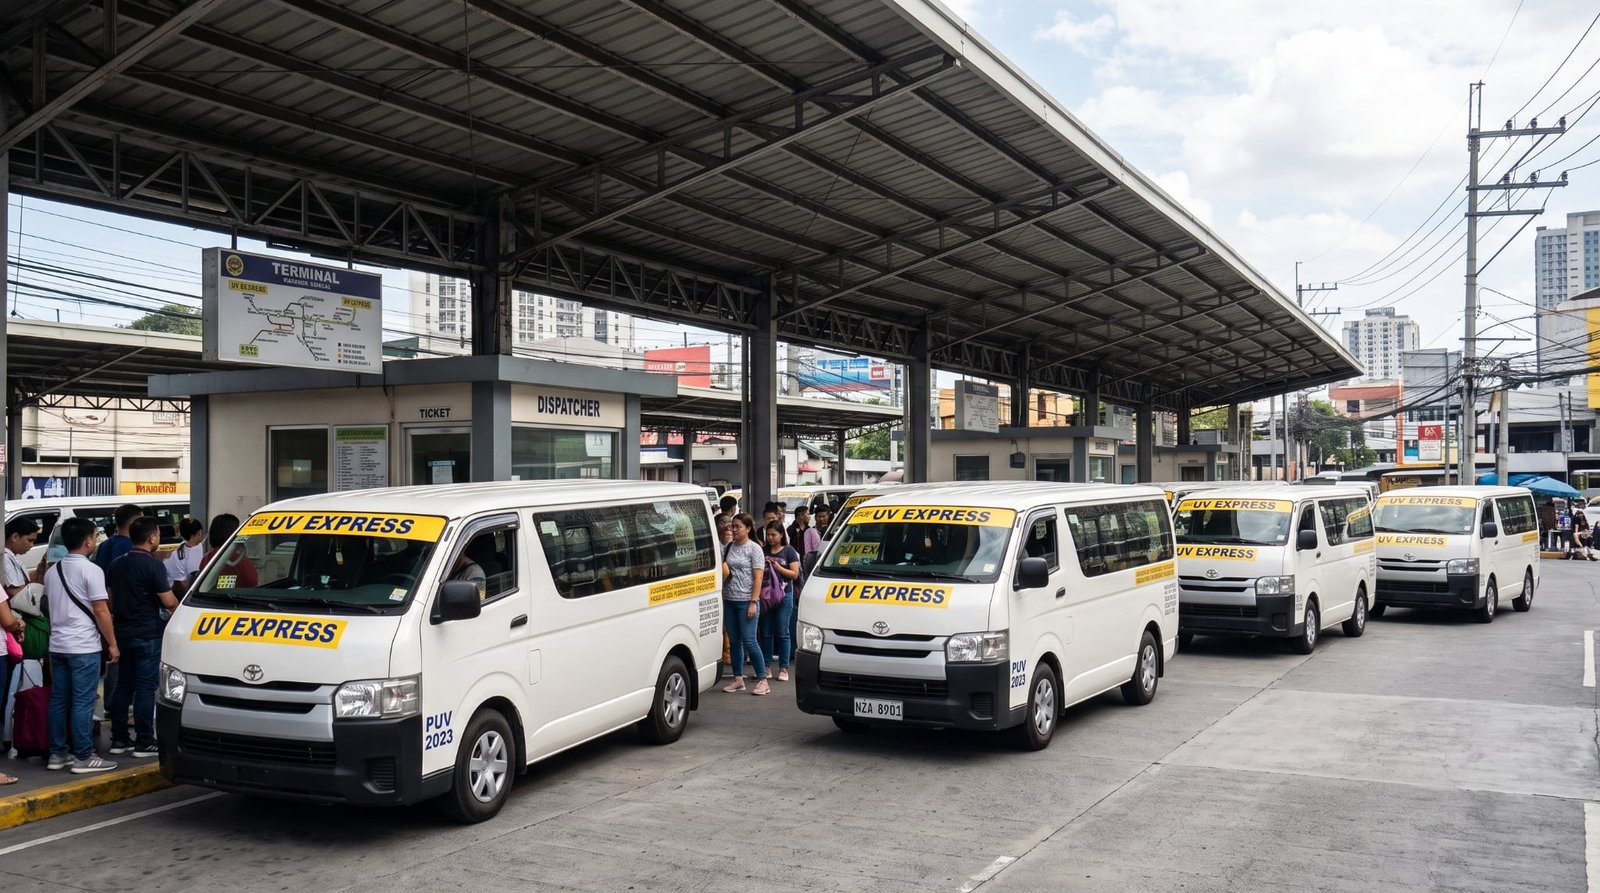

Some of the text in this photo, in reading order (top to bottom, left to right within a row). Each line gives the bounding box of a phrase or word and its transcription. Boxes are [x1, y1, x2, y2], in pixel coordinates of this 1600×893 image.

[272, 262, 340, 284] TERMINAL
[419, 408, 451, 419] TICKET
[537, 395, 600, 418] DISPATCHER
[1193, 501, 1212, 509] UV
[1214, 501, 1276, 510] EXPRESS
[1408, 498, 1463, 506] EXPRESS
[873, 509, 900, 520] UV
[902, 509, 991, 523] EXPRESS
[268, 516, 304, 531] UV
[304, 516, 415, 534] EXPRESS
[1395, 536, 1445, 545] EXPRESS
[1177, 547, 1254, 559] UV EXPRESS
[831, 585, 945, 604] UV EXPRESS
[197, 617, 338, 643] UV EXPRESS
[1012, 660, 1027, 674] PUV
[1011, 674, 1026, 688] 2023
[855, 701, 902, 716] NZA 8901
[426, 711, 453, 732] PUV
[425, 729, 453, 751] 2023
